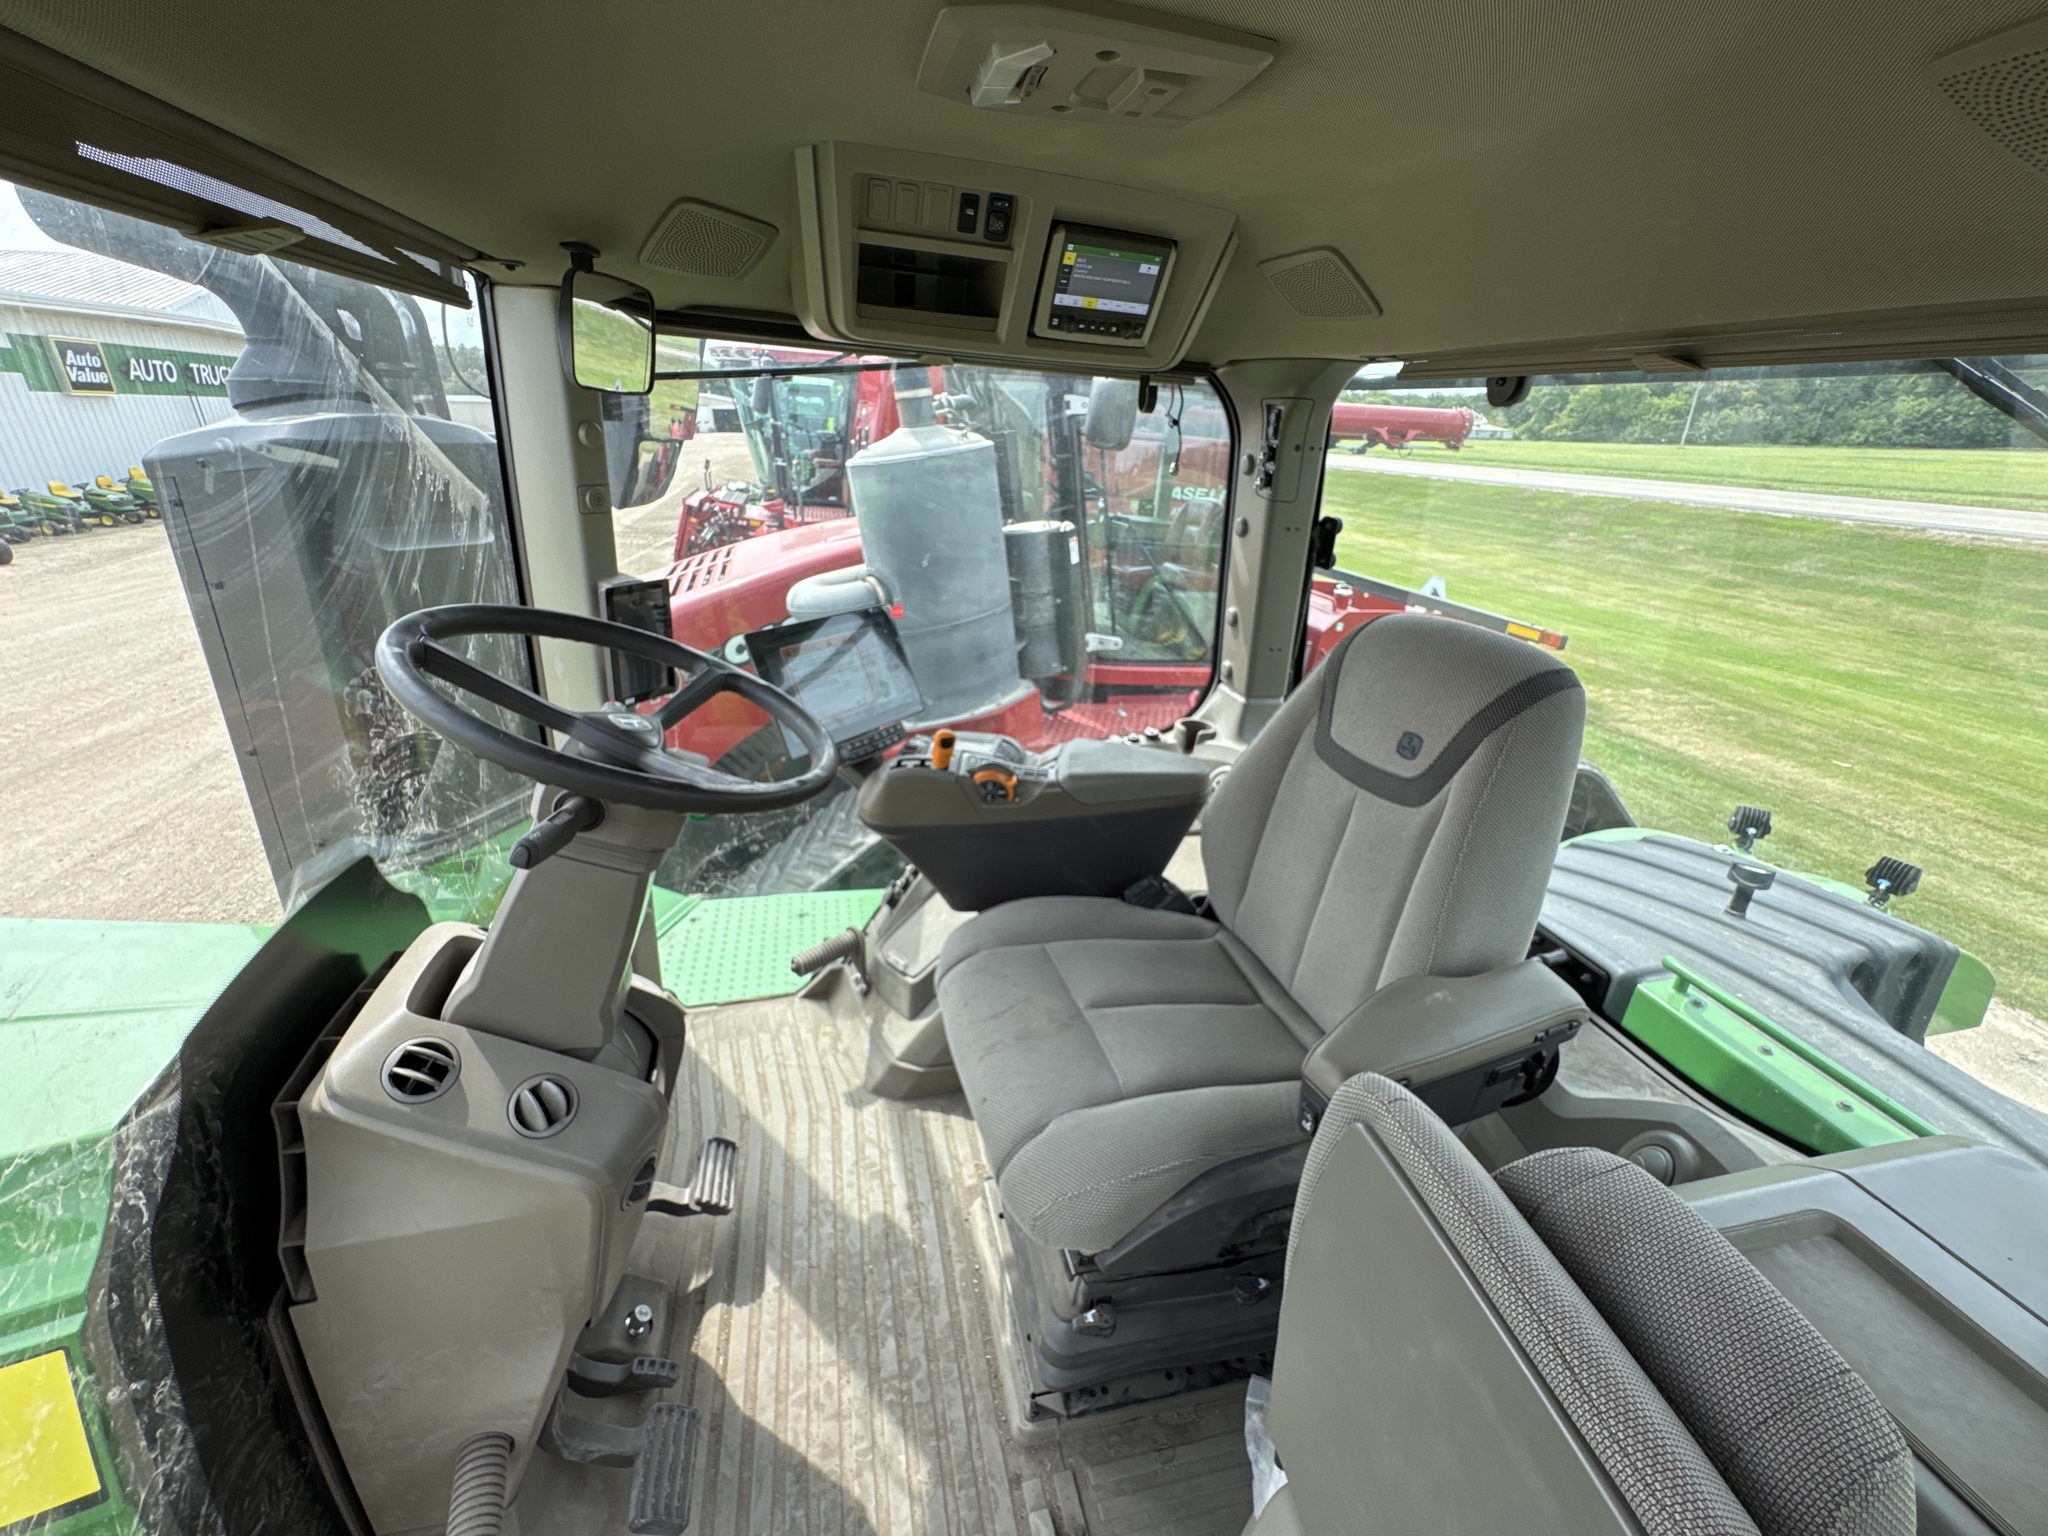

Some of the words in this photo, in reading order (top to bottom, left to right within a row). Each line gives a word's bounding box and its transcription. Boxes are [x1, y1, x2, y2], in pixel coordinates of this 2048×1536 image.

[66, 349, 102, 368] Auto
[65, 365, 109, 384] Value
[129, 357, 178, 383] AUTO
[189, 362, 231, 386] TRUC
